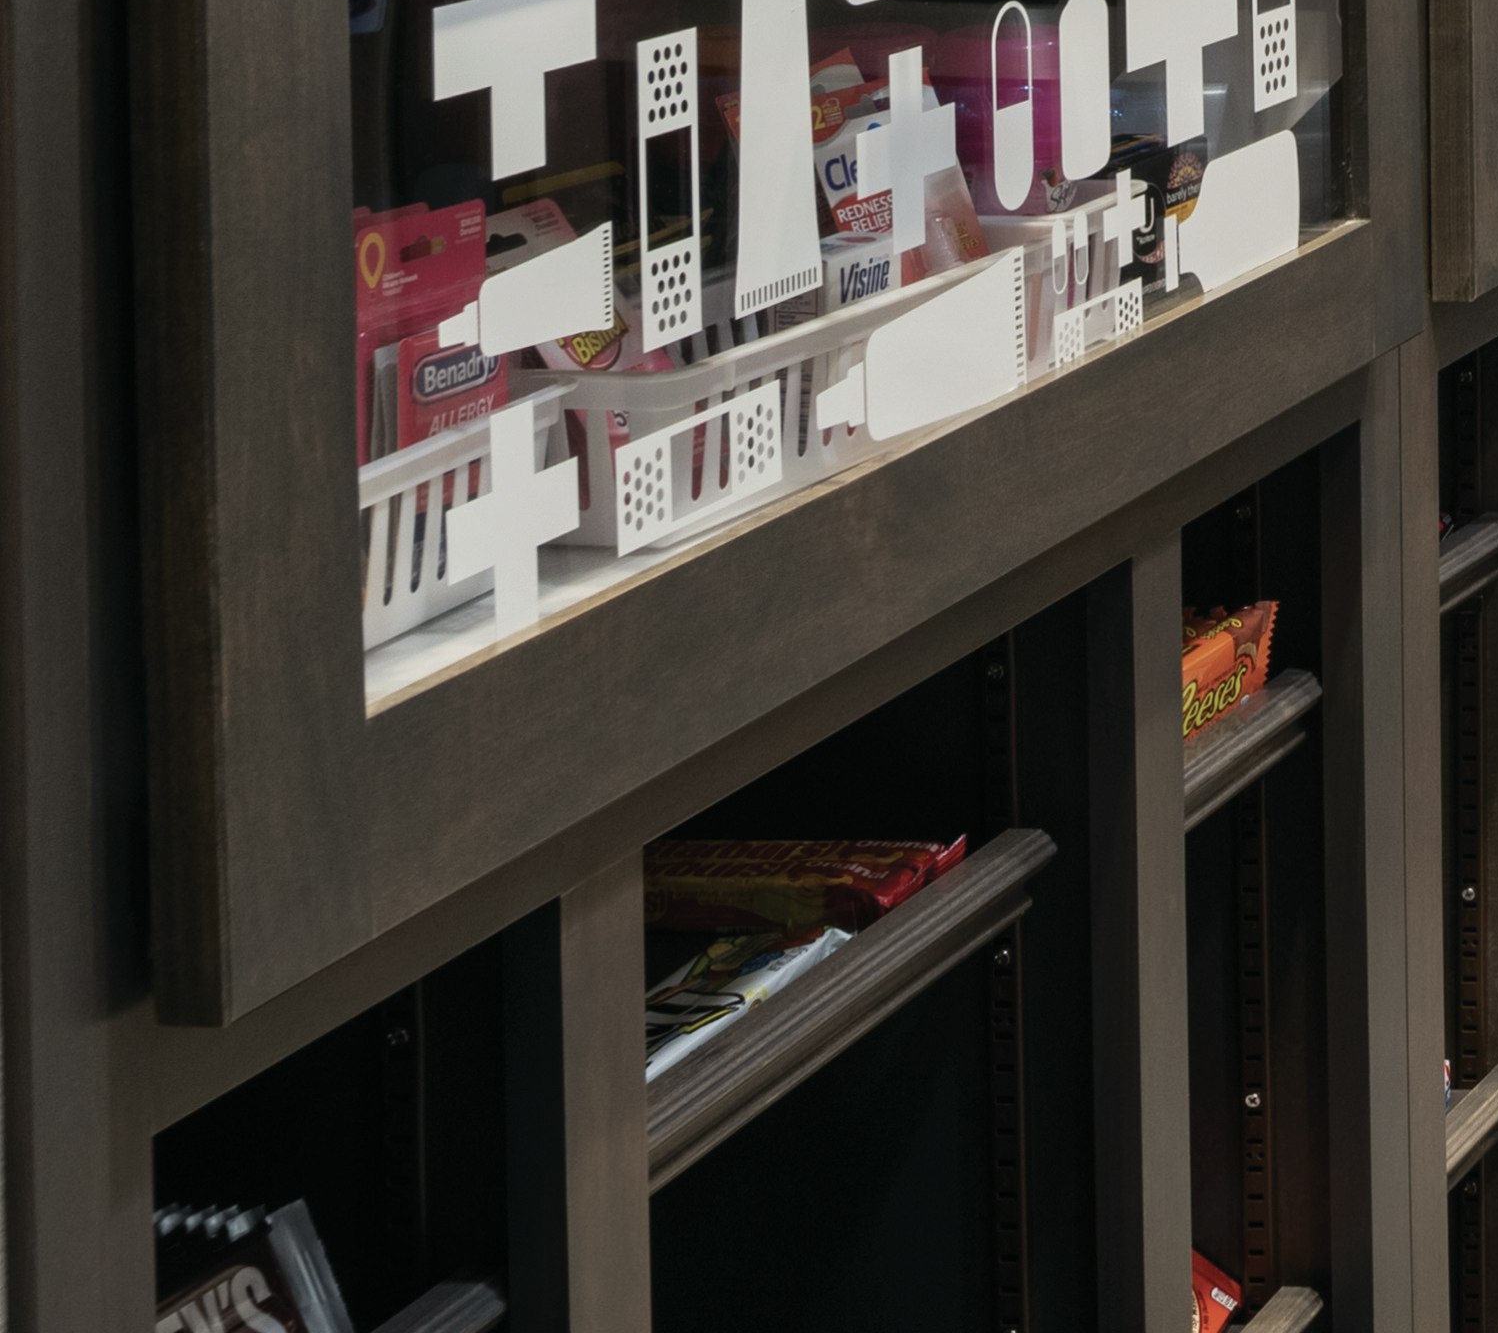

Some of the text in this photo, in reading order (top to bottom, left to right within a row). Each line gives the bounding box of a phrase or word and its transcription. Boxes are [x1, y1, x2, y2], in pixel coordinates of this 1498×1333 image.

[836, 193, 893, 224] REDNESS
[851, 212, 892, 234] RELIEF
[840, 255, 891, 305] Visine
[423, 351, 497, 394] Benadryl
[429, 394, 495, 435] ALLERGY
